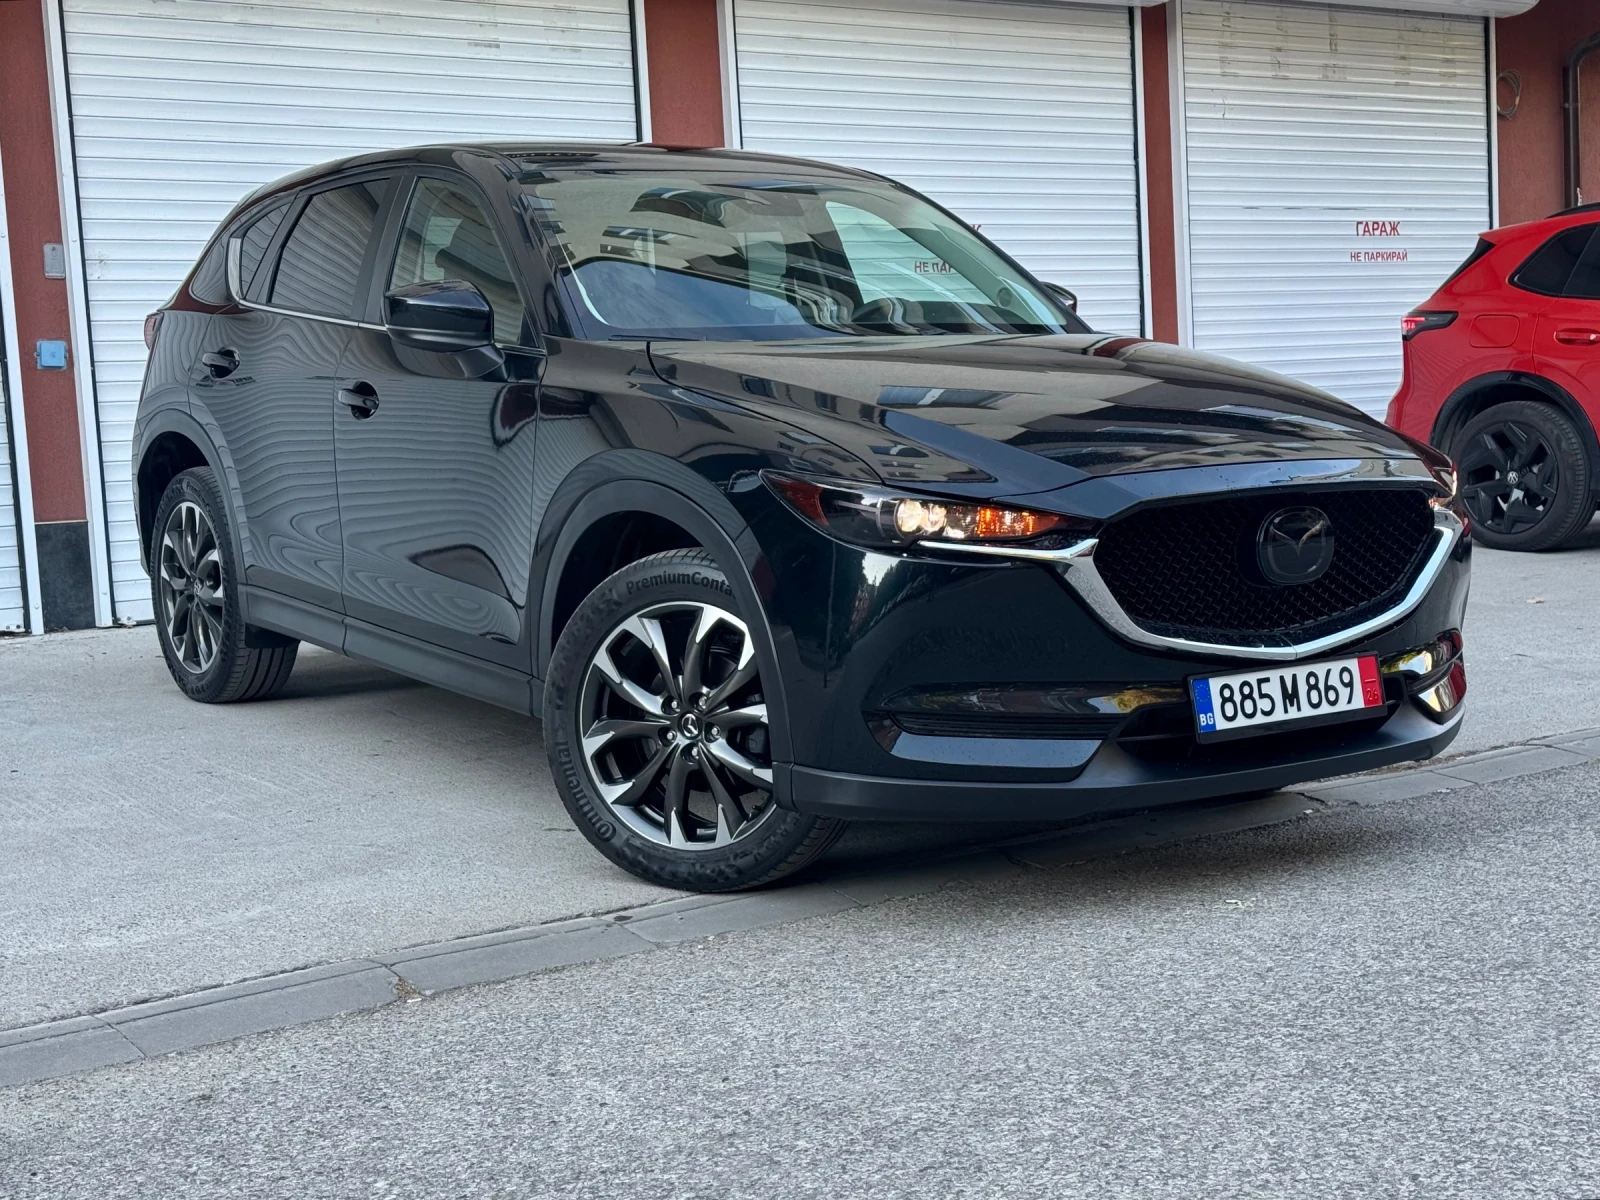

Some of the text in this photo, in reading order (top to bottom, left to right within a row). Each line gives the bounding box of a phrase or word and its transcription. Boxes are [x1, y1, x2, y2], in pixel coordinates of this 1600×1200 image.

[1356, 221, 1400, 236] ГАРАЖ
[1350, 249, 1408, 262] НЕ ПАРКИРАЙ
[914, 261, 929, 273] НЕ
[626, 570, 735, 598] PremiumConta
[1200, 712, 1214, 726] BG
[555, 740, 617, 843] Continental
